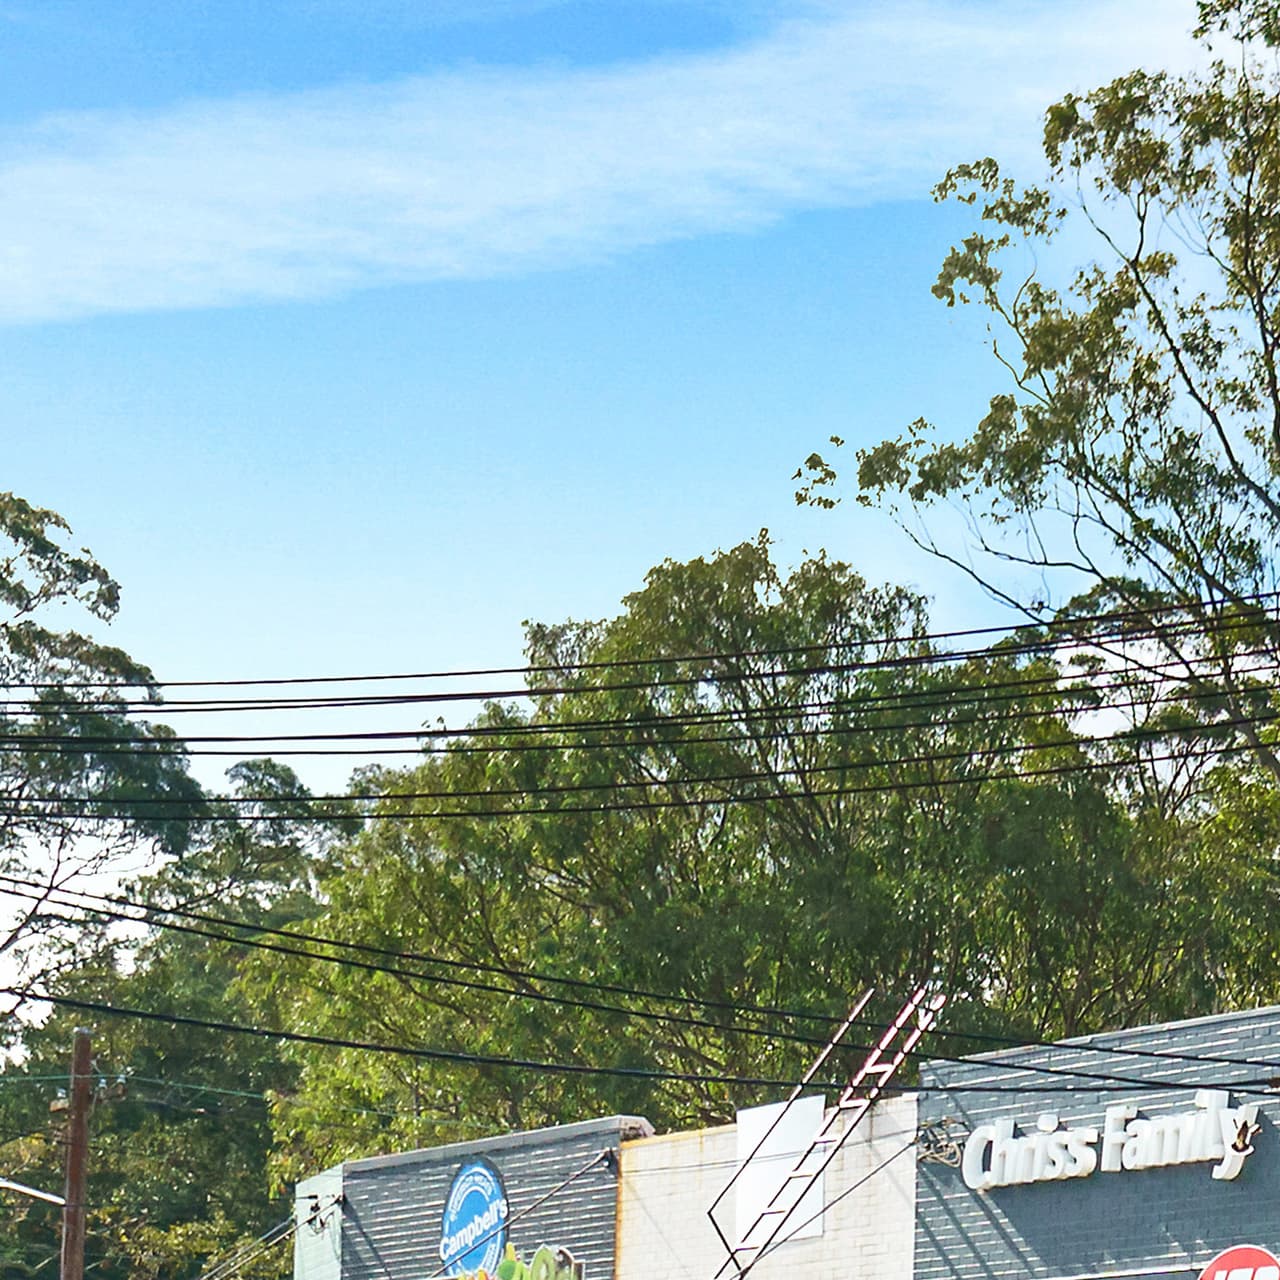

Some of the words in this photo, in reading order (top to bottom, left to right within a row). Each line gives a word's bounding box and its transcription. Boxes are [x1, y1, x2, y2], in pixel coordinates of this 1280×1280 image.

[962, 1114, 1099, 1190] Chriss
[1100, 1090, 1260, 1181] Family
[440, 1198, 508, 1260] Campbell's
